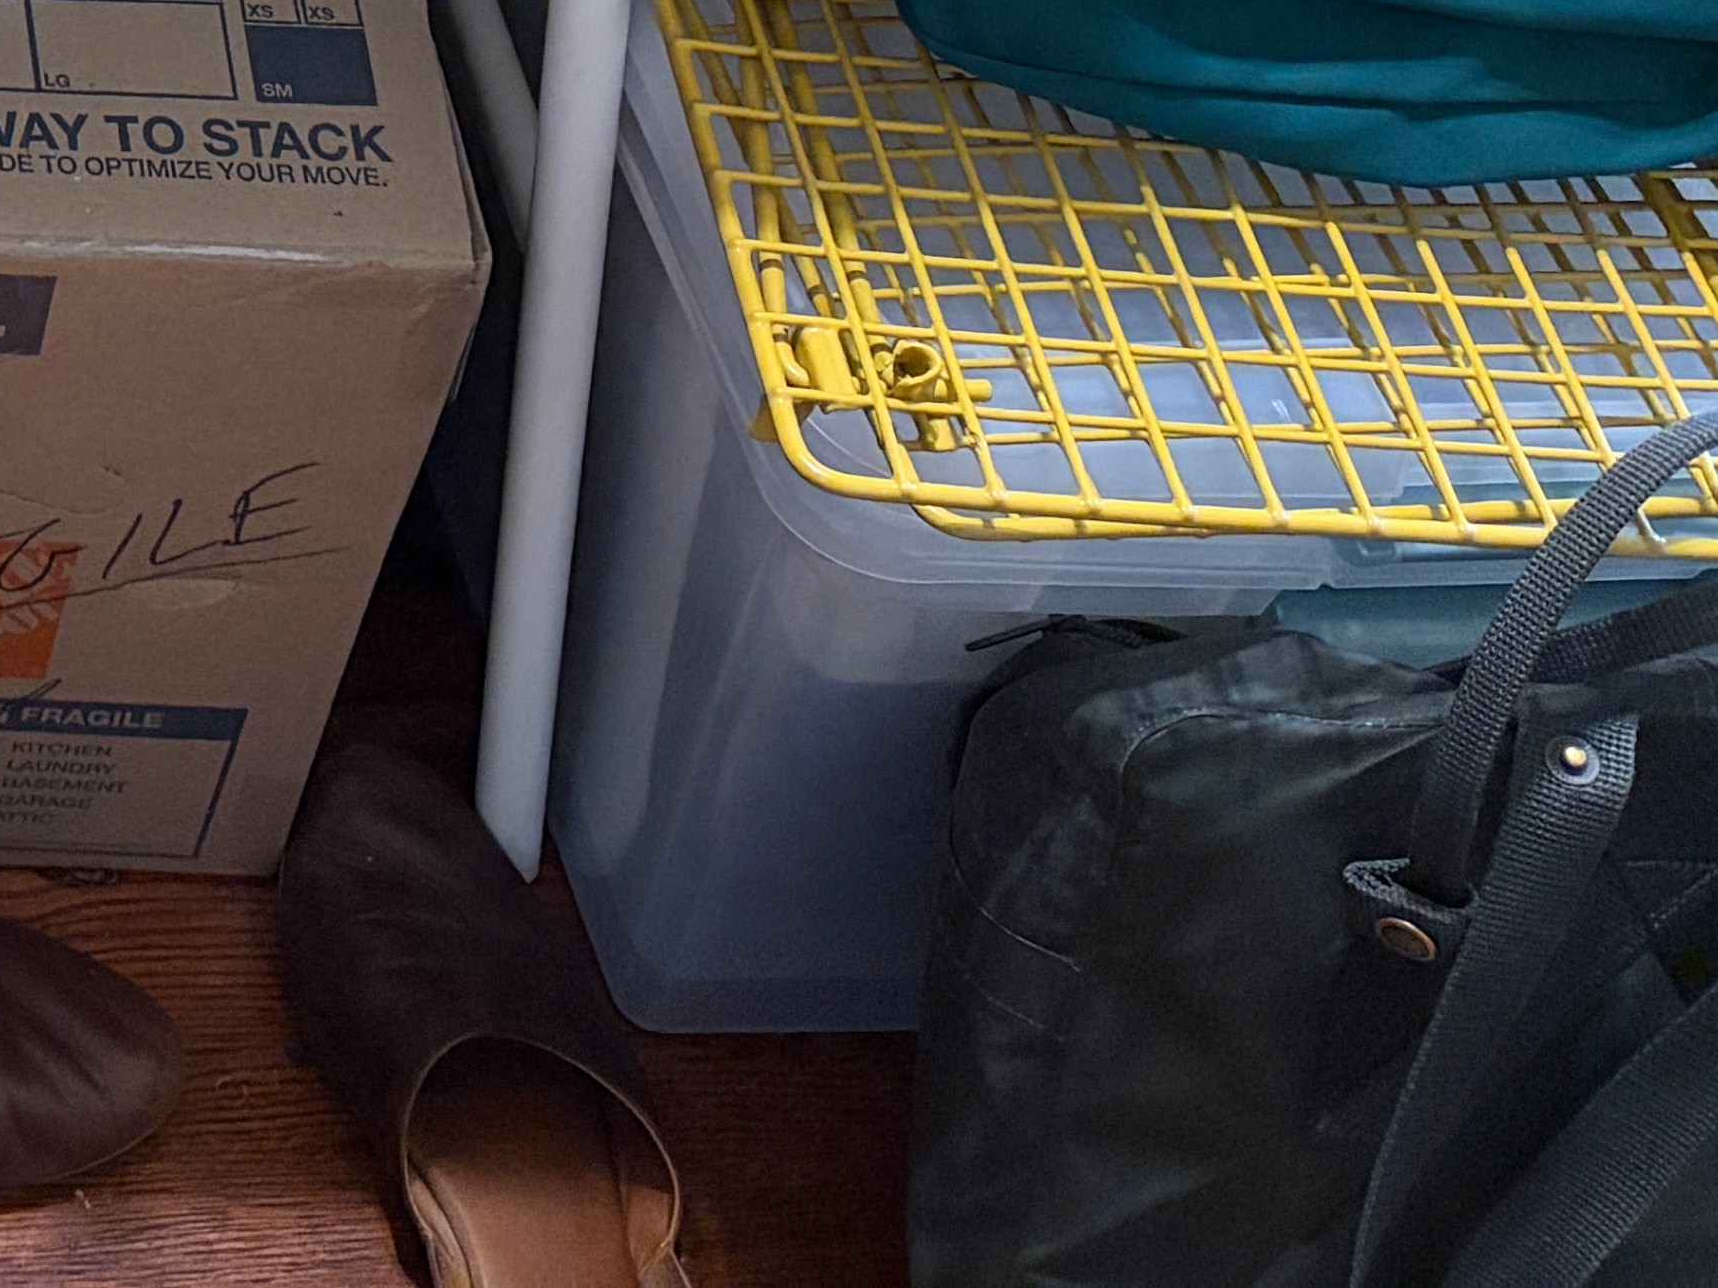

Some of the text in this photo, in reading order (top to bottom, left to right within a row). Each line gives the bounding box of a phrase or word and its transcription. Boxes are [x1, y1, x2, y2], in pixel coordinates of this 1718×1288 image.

[247, 4, 273, 18] XS
[308, 7, 335, 21] XS
[44, 74, 71, 88] LG
[261, 83, 293, 98] SM
[104, 115, 184, 154] TO
[202, 119, 393, 163] STACK
[39, 155, 77, 175] TO
[85, 157, 213, 180] OPTIMIZE
[216, 162, 295, 183] YOUR
[301, 165, 389, 187] MOVE.
[20, 707, 164, 729] FRAGILE
[11, 741, 113, 758] KITCHEN
[6, 760, 116, 775] LAUNDRY
[2, 777, 129, 794] BASEMENT
